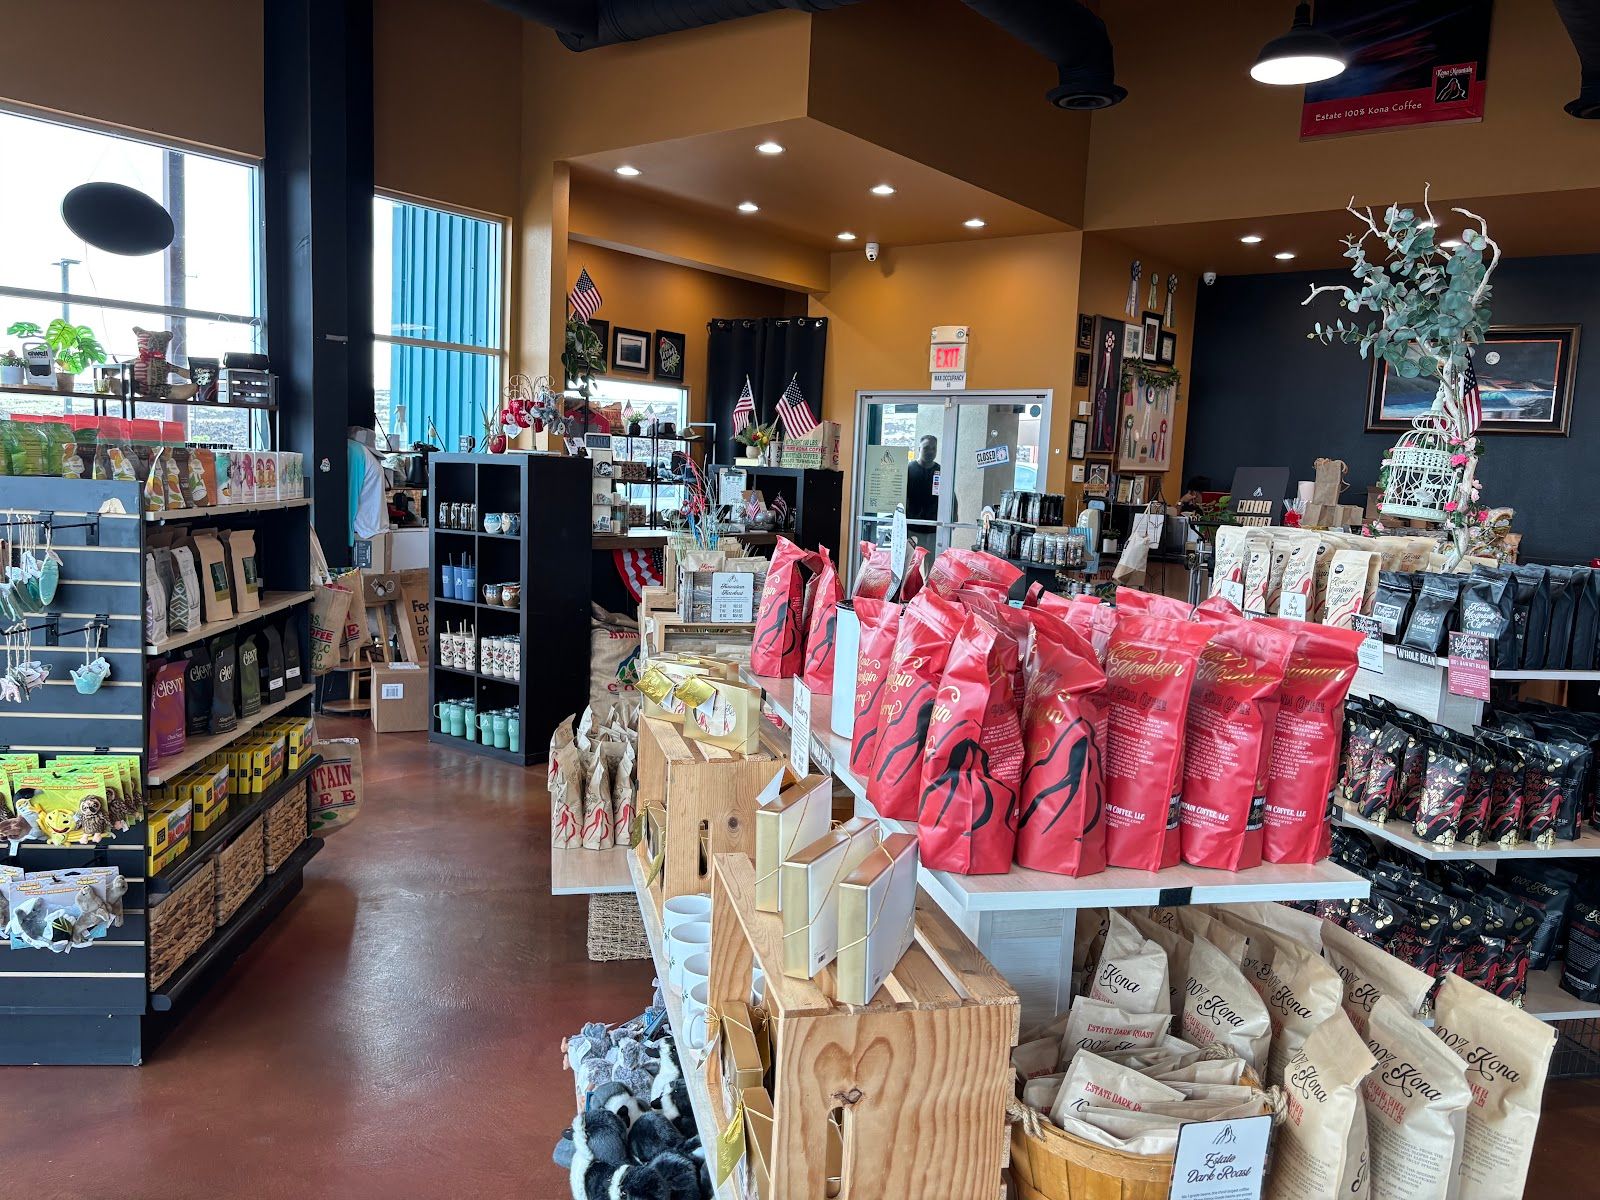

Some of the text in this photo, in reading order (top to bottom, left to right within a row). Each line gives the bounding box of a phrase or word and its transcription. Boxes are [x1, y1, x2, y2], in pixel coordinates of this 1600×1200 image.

[1315, 100, 1422, 122] Estate 100% Kona Coffee
[935, 347, 960, 368] EXIT
[976, 450, 996, 463] CLOSED
[1396, 647, 1420, 662] WHOLE
[1420, 652, 1436, 667] BEAN
[1108, 659, 1184, 684] Mountain
[1112, 806, 1146, 820] COFFEE, LLC
[1196, 806, 1218, 818] COFFEE,
[1219, 812, 1230, 822] LLC
[1272, 806, 1295, 818] COFFEE,
[1099, 964, 1140, 994] Kona
[1196, 995, 1245, 1028] Kona
[1270, 986, 1312, 1018] Kona
[1088, 1024, 1154, 1039] ESTATE DARK ROAST
[1466, 1046, 1521, 1082] Kona
[1292, 1066, 1328, 1103] Kona
[1382, 1062, 1442, 1102] Kona
[1084, 1082, 1112, 1100] ESTATE
[1112, 1094, 1131, 1110] DARK
[1204, 1152, 1236, 1168] Estate
[1186, 1166, 1252, 1183] Dark Roast
